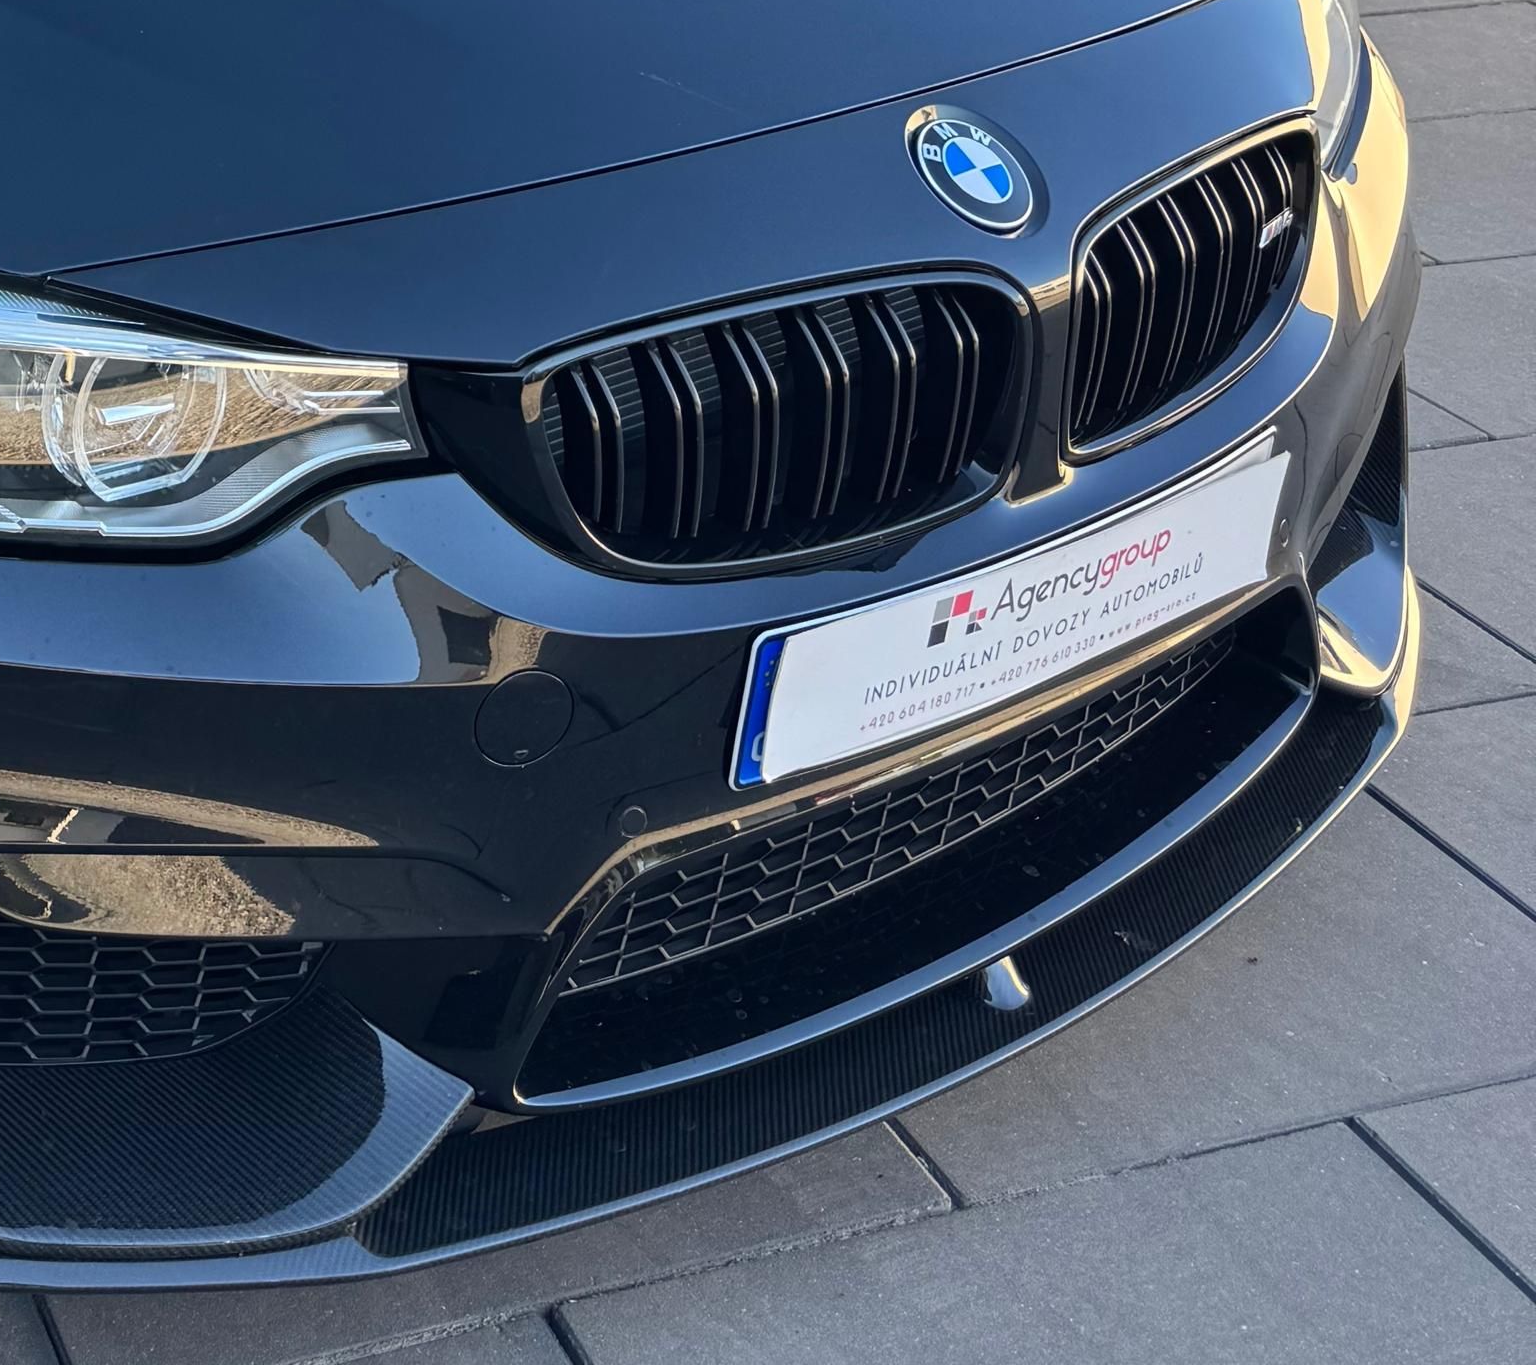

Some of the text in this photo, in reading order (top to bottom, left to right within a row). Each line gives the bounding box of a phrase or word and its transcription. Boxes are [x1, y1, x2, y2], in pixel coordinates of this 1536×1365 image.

[923, 122, 992, 162] BMW
[990, 529, 1172, 623] Agencygroup
[864, 551, 1204, 706] INDIVIDUÁLNÍ DOVOZY AUTOMOBILŮ
[860, 711, 895, 731] +420
[898, 700, 927, 720] 604
[930, 691, 952, 710] 180
[955, 682, 977, 701] 717
[1025, 654, 1049, 674] 776
[1051, 645, 1072, 664] 610
[1074, 634, 1096, 654] 330
